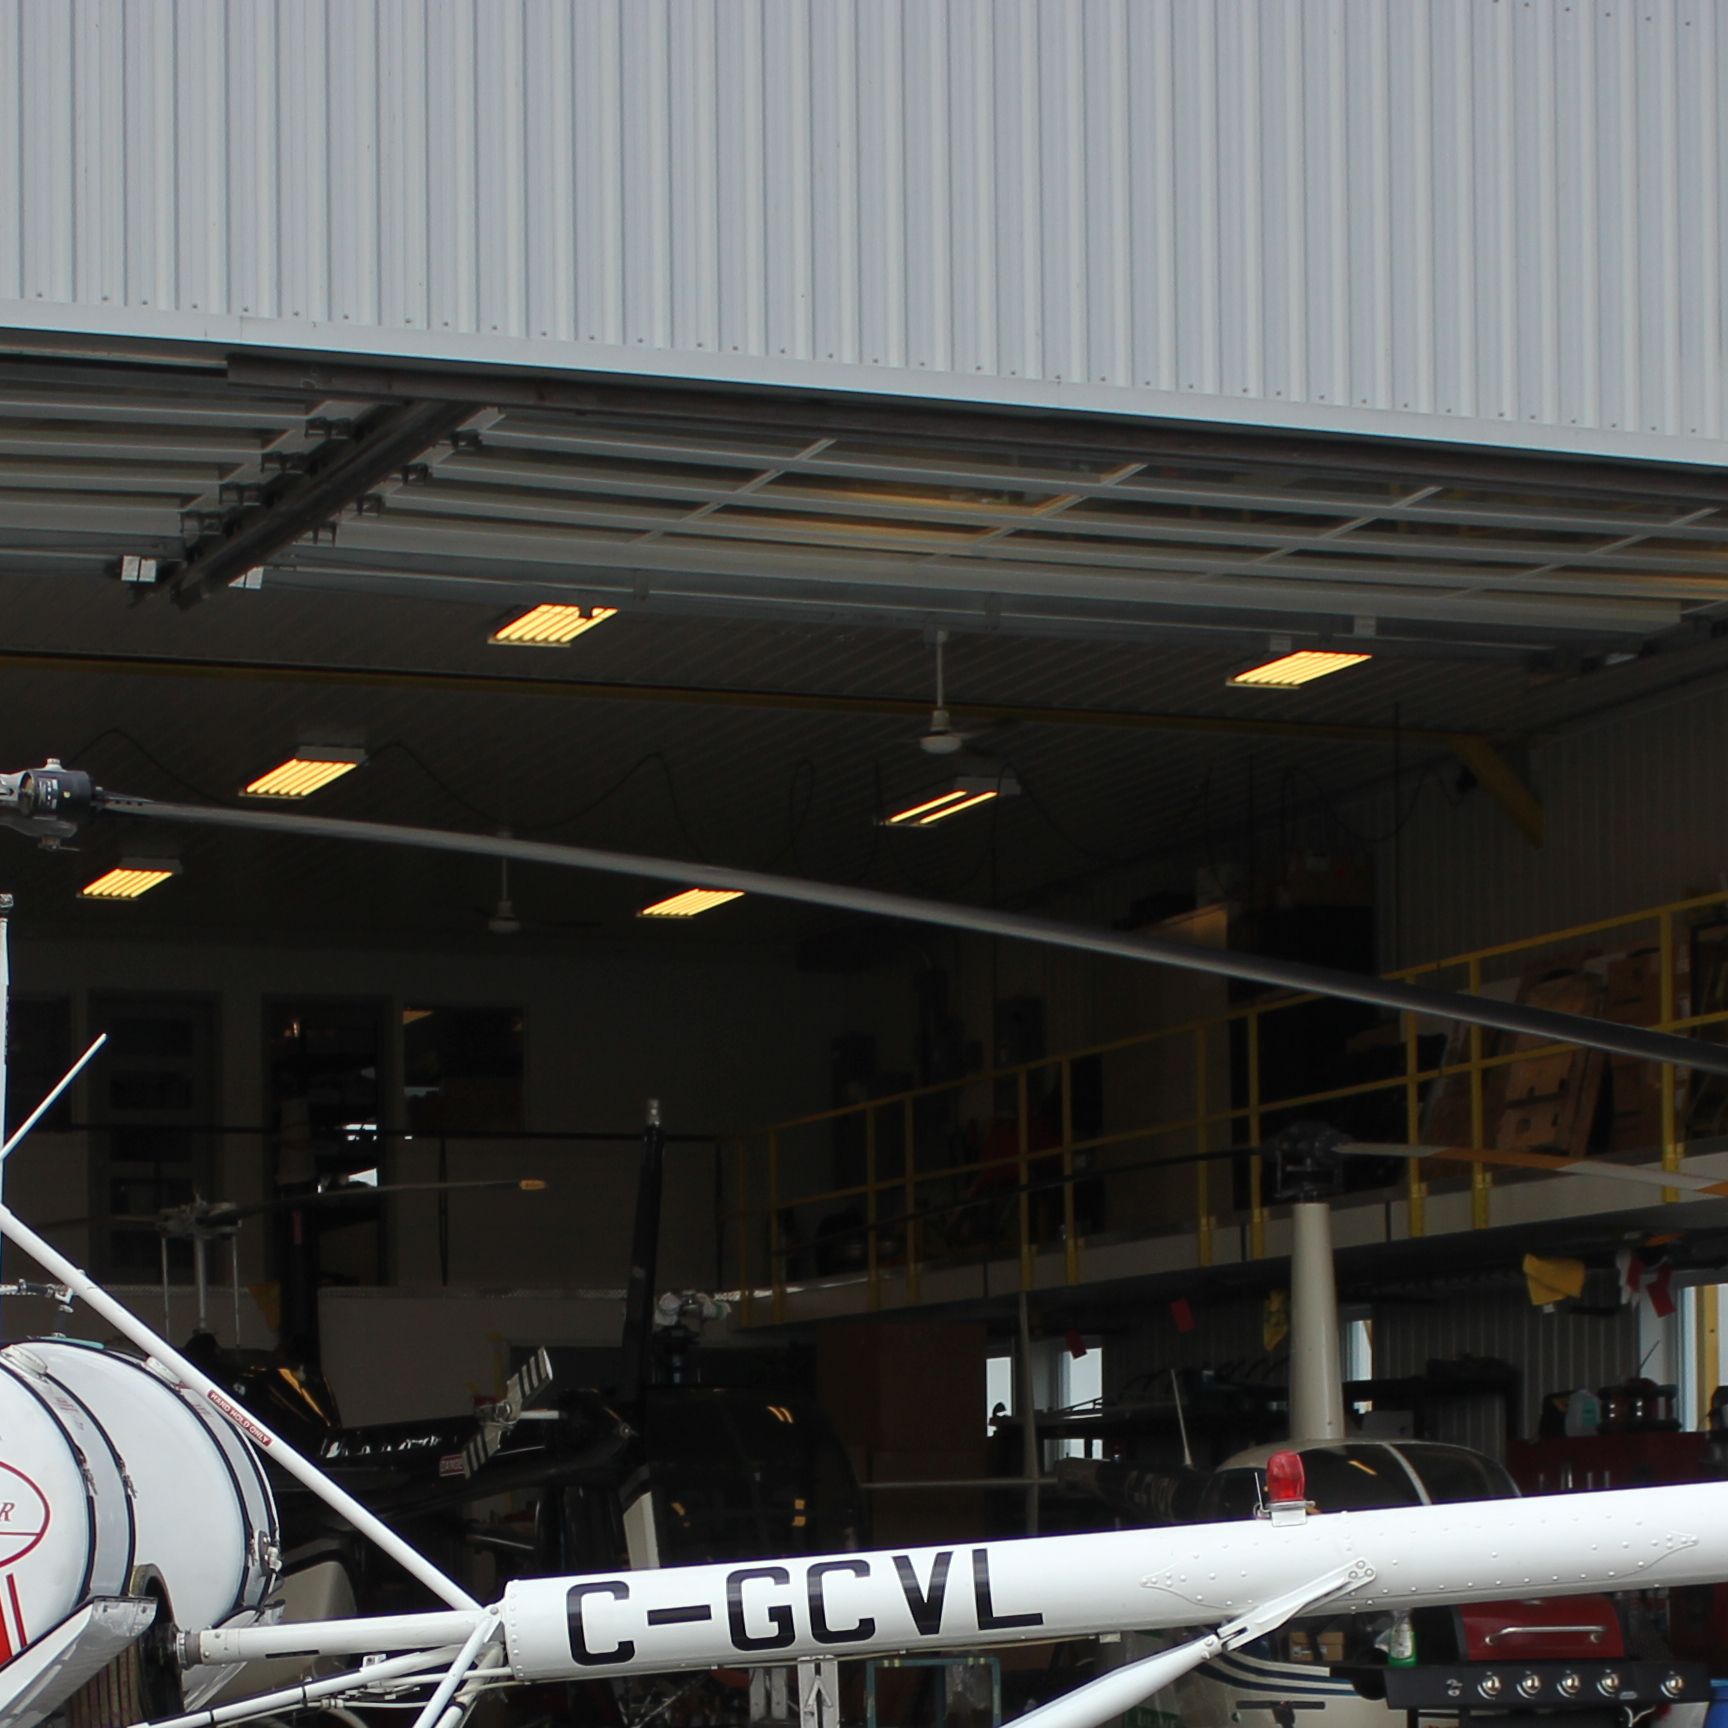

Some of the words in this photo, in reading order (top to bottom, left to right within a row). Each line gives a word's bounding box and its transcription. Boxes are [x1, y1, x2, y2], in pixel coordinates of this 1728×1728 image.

[210, 1393, 231, 1413] HAND
[229, 1409, 250, 1428] HOLD
[249, 1426, 269, 1443] ONLY
[566, 1548, 1044, 1666] C-GCVL
